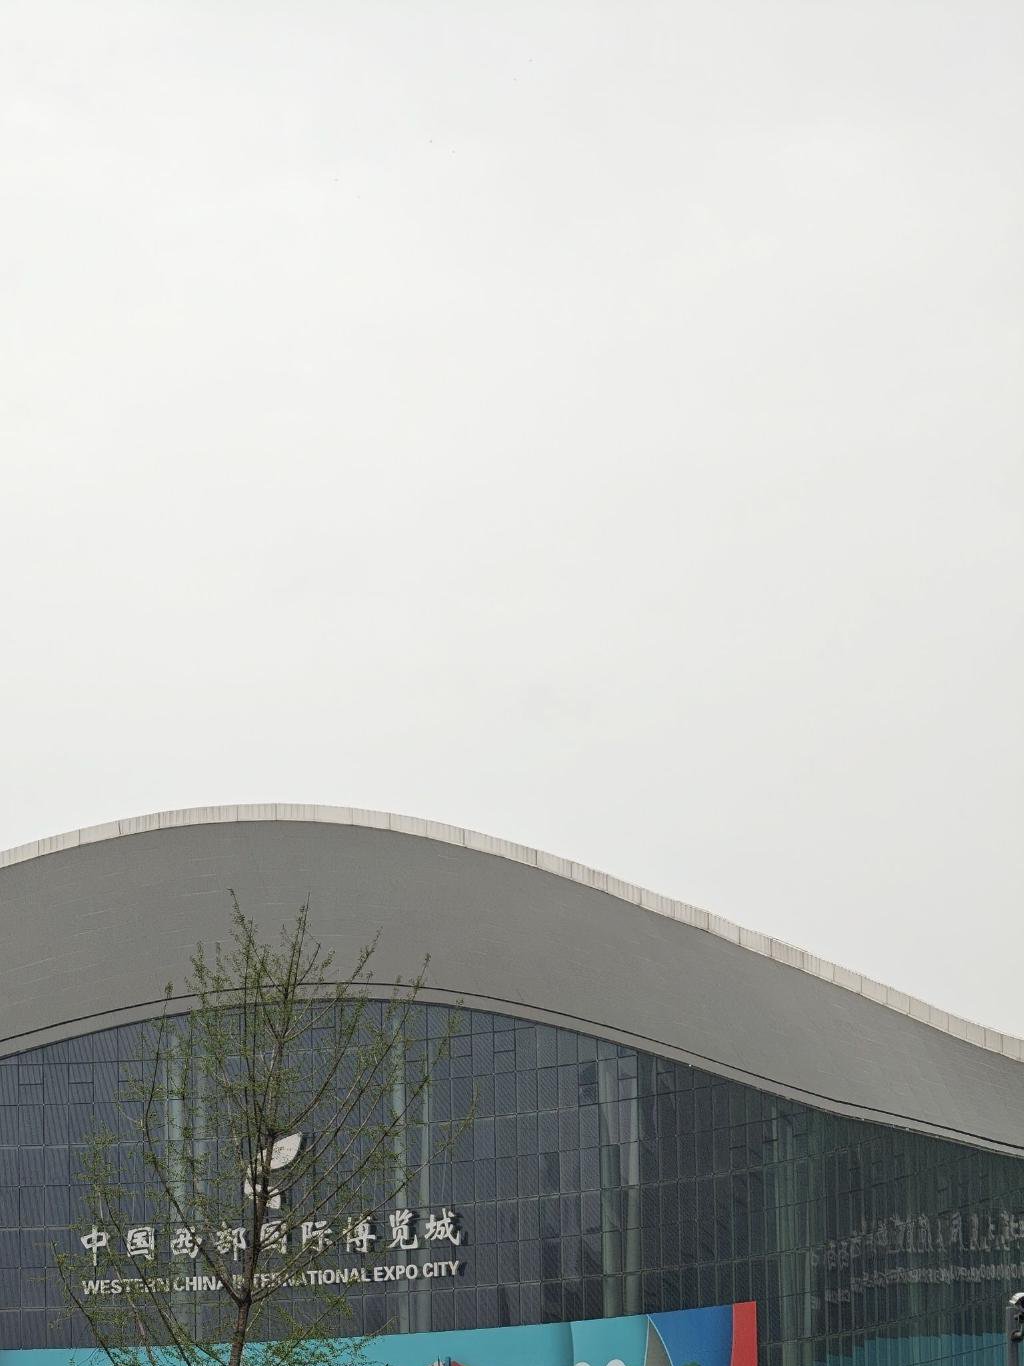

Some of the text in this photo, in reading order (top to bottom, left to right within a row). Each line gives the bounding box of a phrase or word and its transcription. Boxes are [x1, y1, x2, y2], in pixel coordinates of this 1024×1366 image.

[80, 1208, 461, 1267] 中国西部国际博览城
[81, 1277, 170, 1296] WESTERN
[172, 1275, 224, 1292] CHINA
[374, 1264, 418, 1283] EXPO
[422, 1260, 459, 1278] CITY
